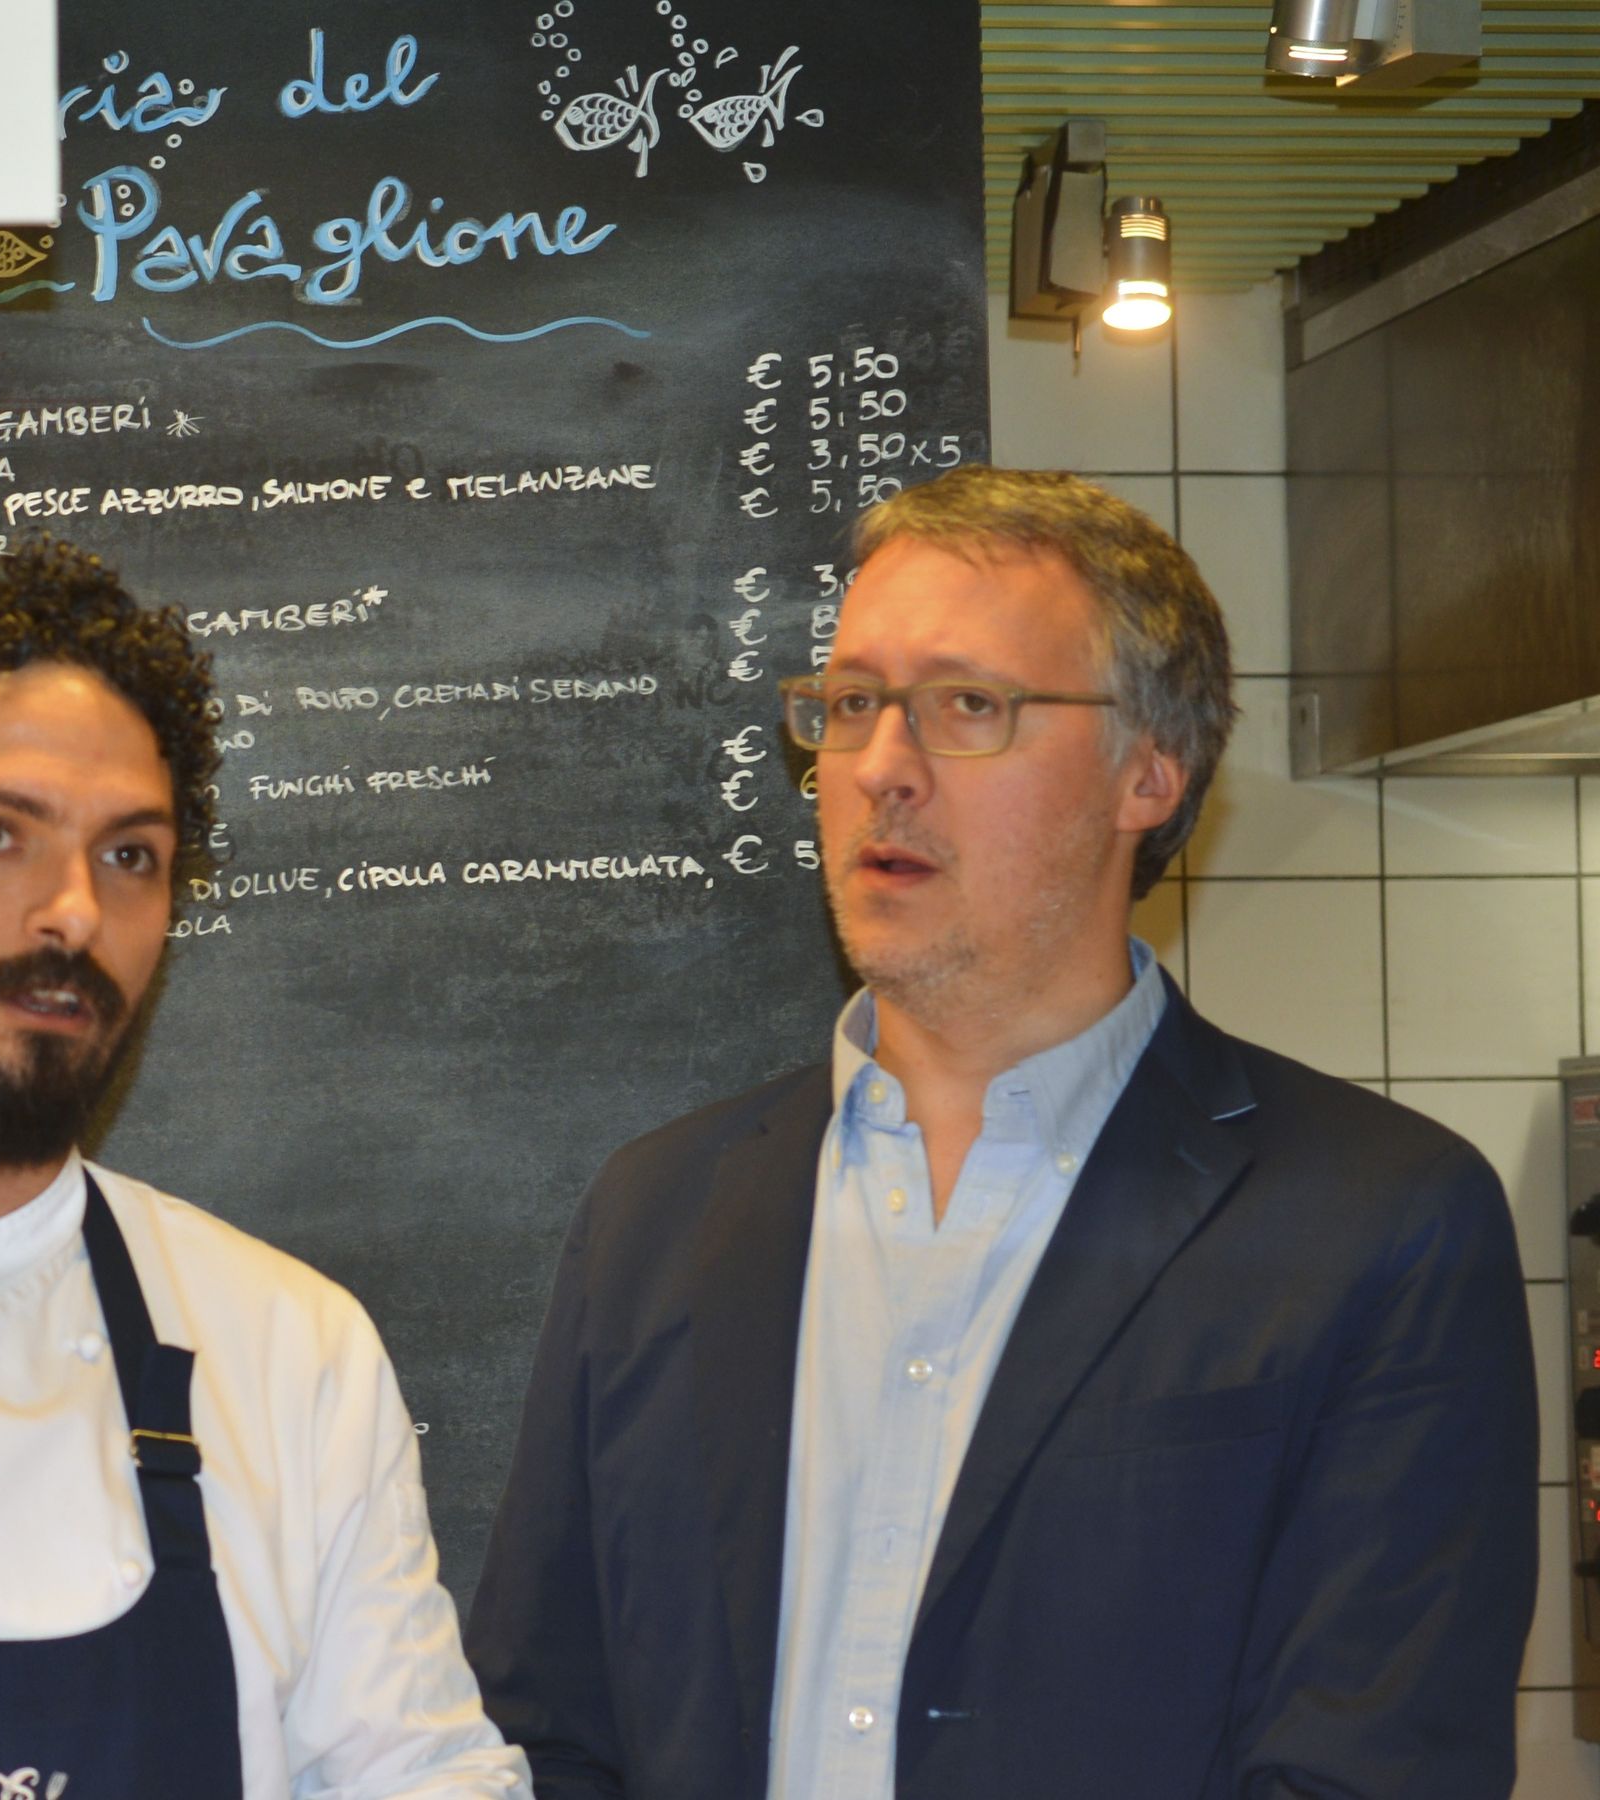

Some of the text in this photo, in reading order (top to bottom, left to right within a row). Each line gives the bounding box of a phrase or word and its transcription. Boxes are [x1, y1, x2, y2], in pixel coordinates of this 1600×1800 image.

[278, 27, 441, 119] del
[76, 165, 617, 306] Pavaglione
[808, 346, 899, 388] 5,50
[809, 389, 907, 430] 5,50
[4, 488, 90, 526] PESCE
[447, 464, 657, 502] MELANZANE
[529, 674, 658, 703] SEDANO
